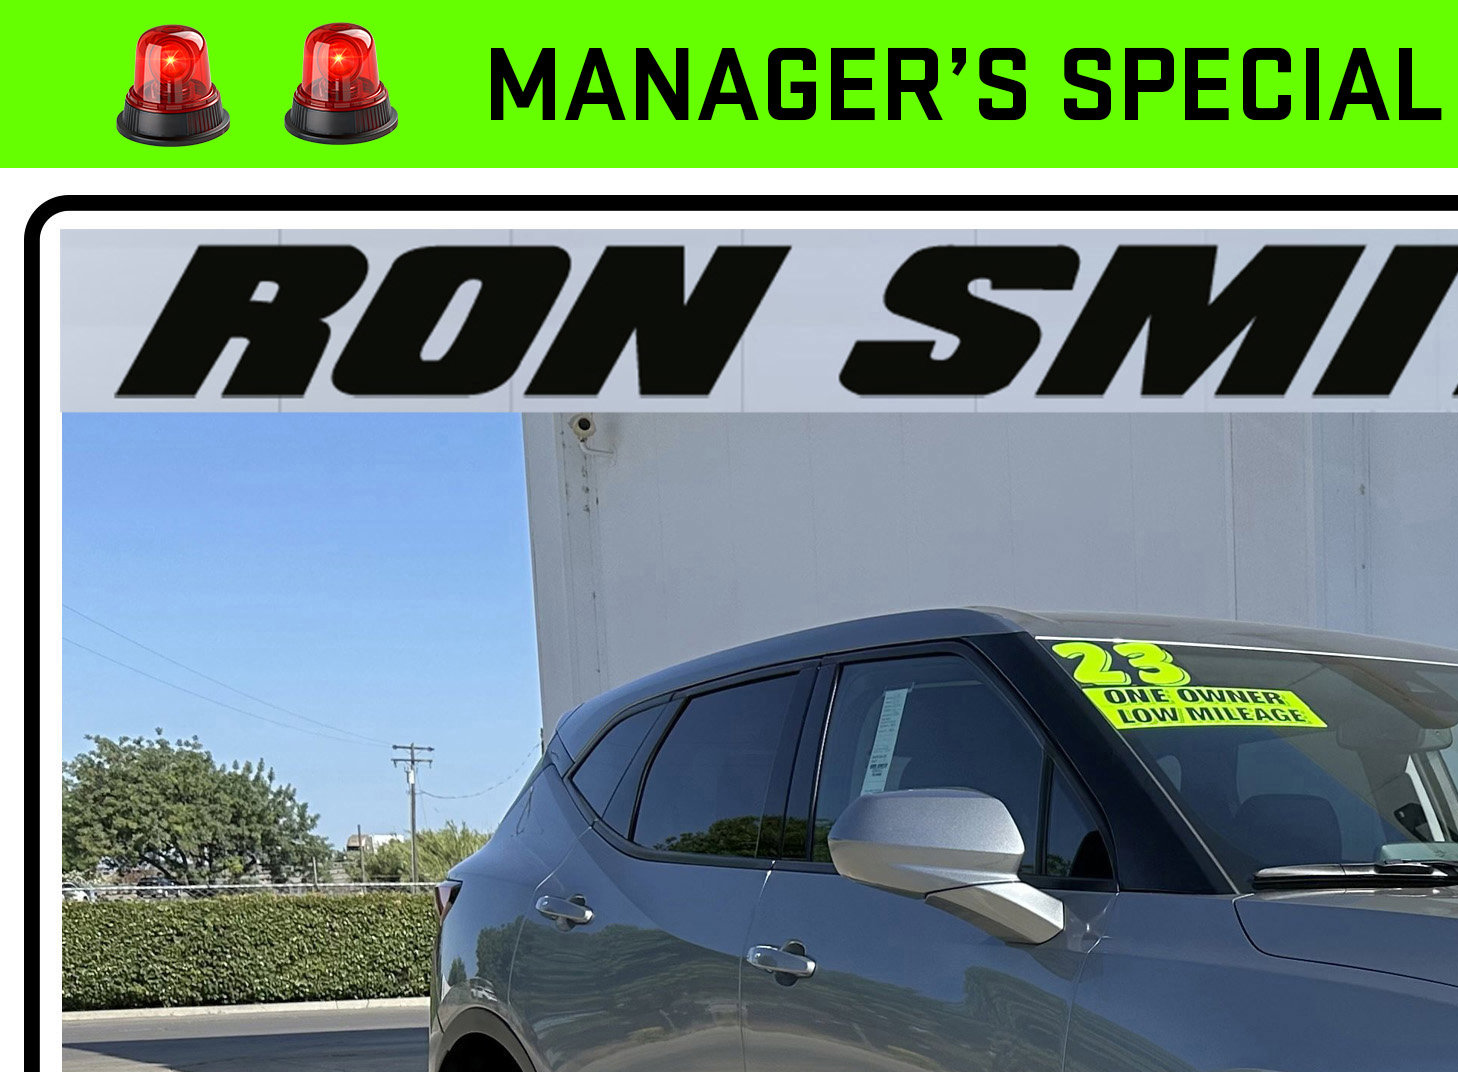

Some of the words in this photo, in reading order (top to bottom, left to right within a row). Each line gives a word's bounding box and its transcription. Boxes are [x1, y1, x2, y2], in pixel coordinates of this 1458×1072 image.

[1051, 641, 1192, 687] 23
[1103, 688, 1168, 705] ONE
[1177, 688, 1286, 706] OWNER
[1116, 706, 1181, 724] LOW
[1187, 706, 1307, 724] MILEAGE
